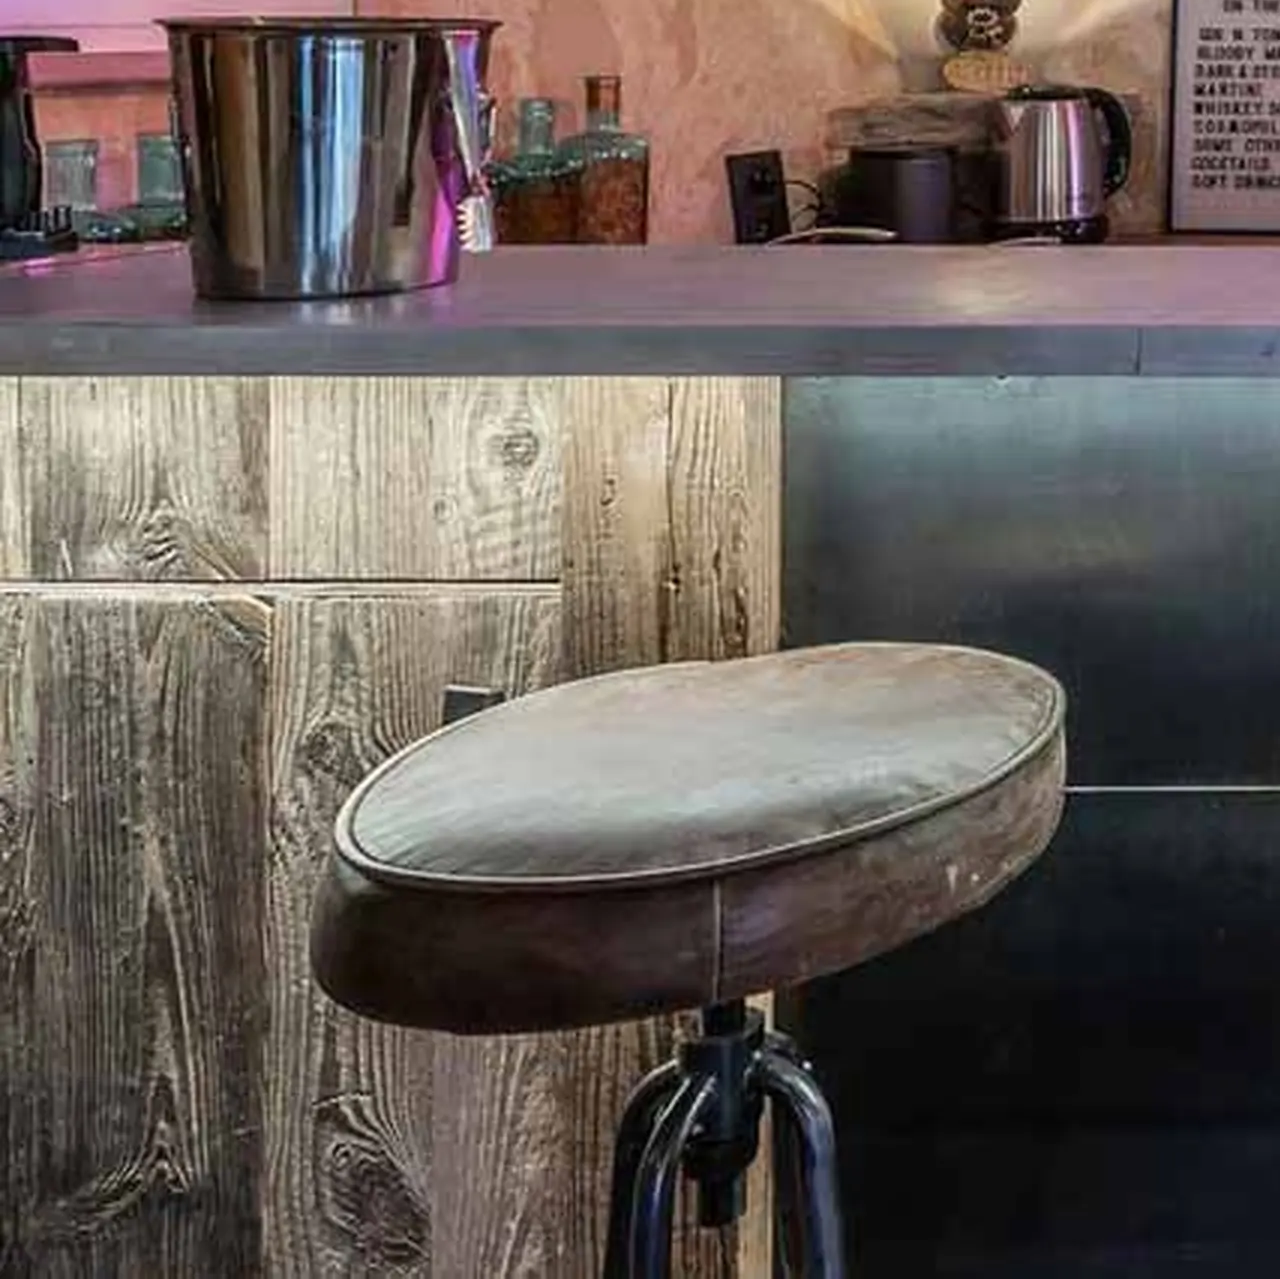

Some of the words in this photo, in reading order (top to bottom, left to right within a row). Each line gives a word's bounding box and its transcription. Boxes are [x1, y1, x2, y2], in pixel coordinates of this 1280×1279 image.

[1197, 46, 1254, 60] BLOODY
[1195, 64, 1234, 78] DARK
[1194, 83, 1262, 97] MARTINI
[1194, 101, 1263, 115] WHISKEY
[1193, 138, 1233, 152] SOME
[1191, 174, 1228, 188] SOFT
